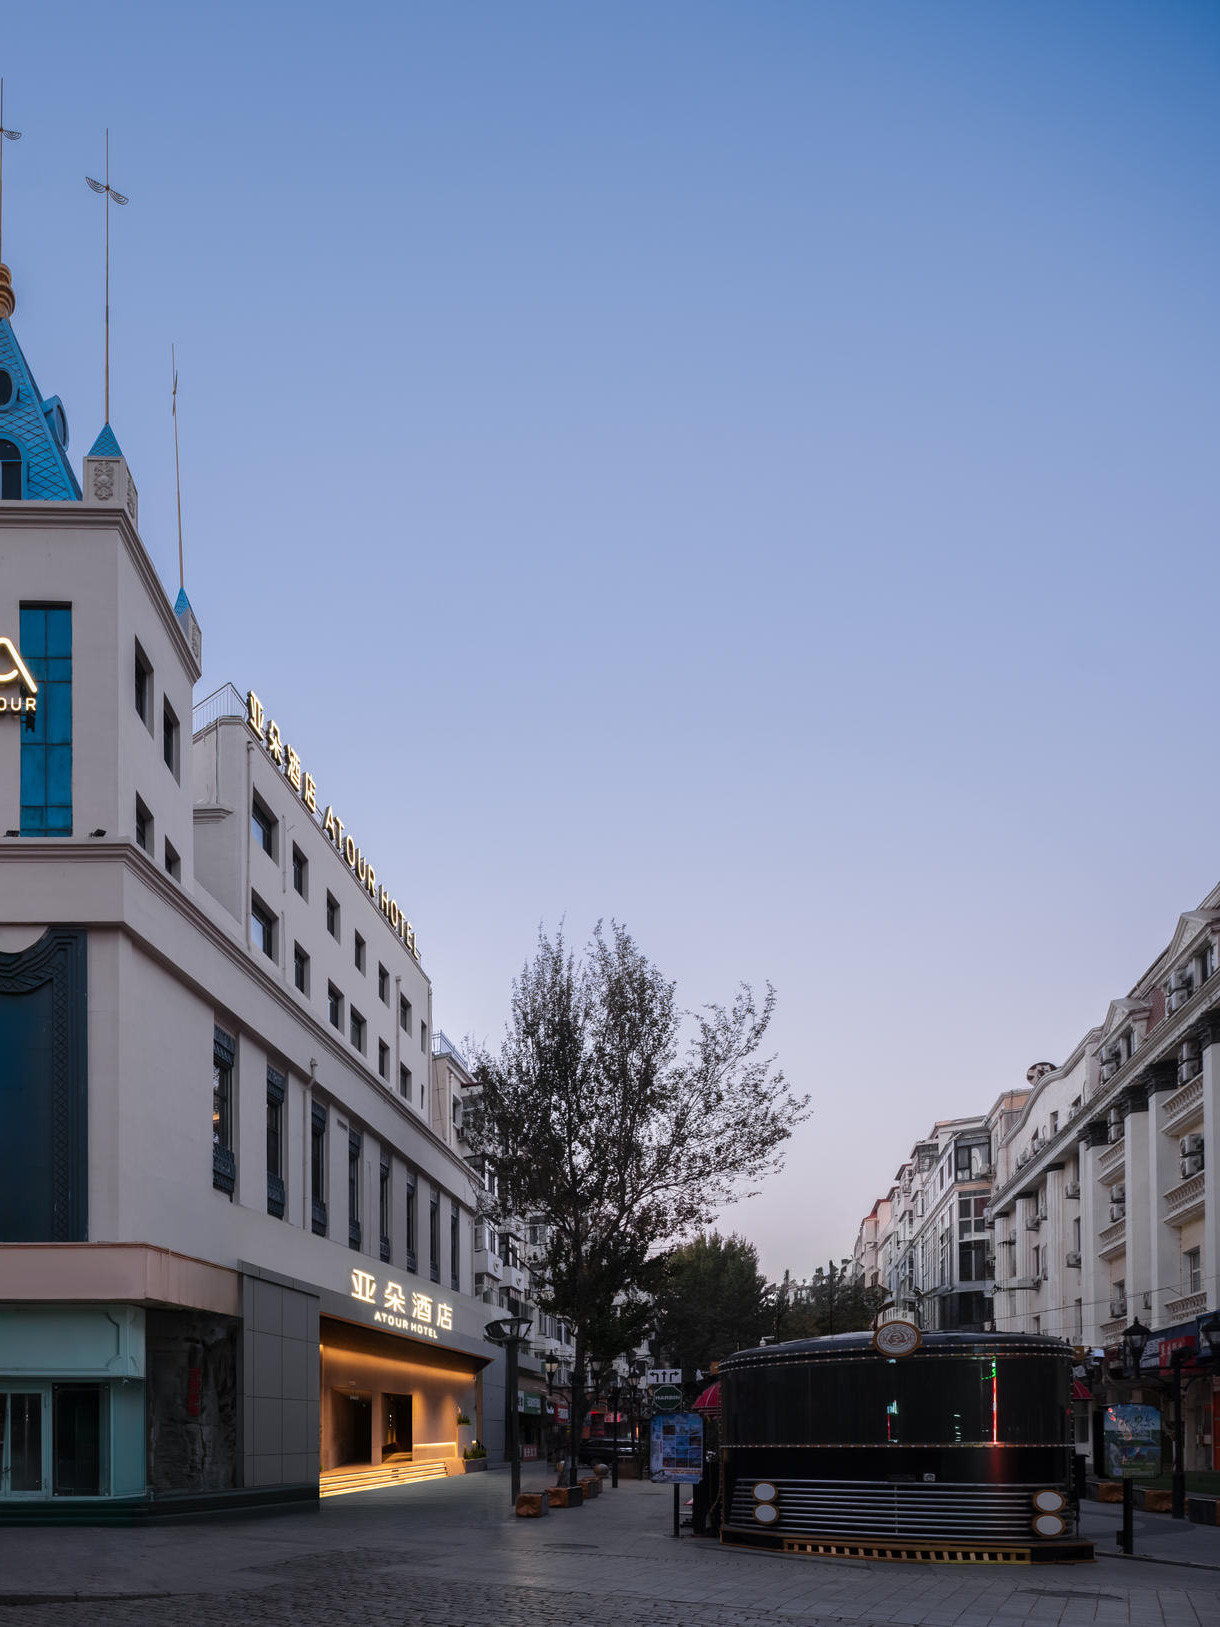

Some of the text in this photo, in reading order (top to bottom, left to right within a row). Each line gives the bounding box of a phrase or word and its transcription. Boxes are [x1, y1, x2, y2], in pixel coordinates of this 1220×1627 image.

[247, 690, 420, 960] 亚朵酒店 ATOUR HOTEL
[352, 1269, 452, 1331] 亚朵酒店
[374, 1311, 439, 1339] ATOUR HOTEL
